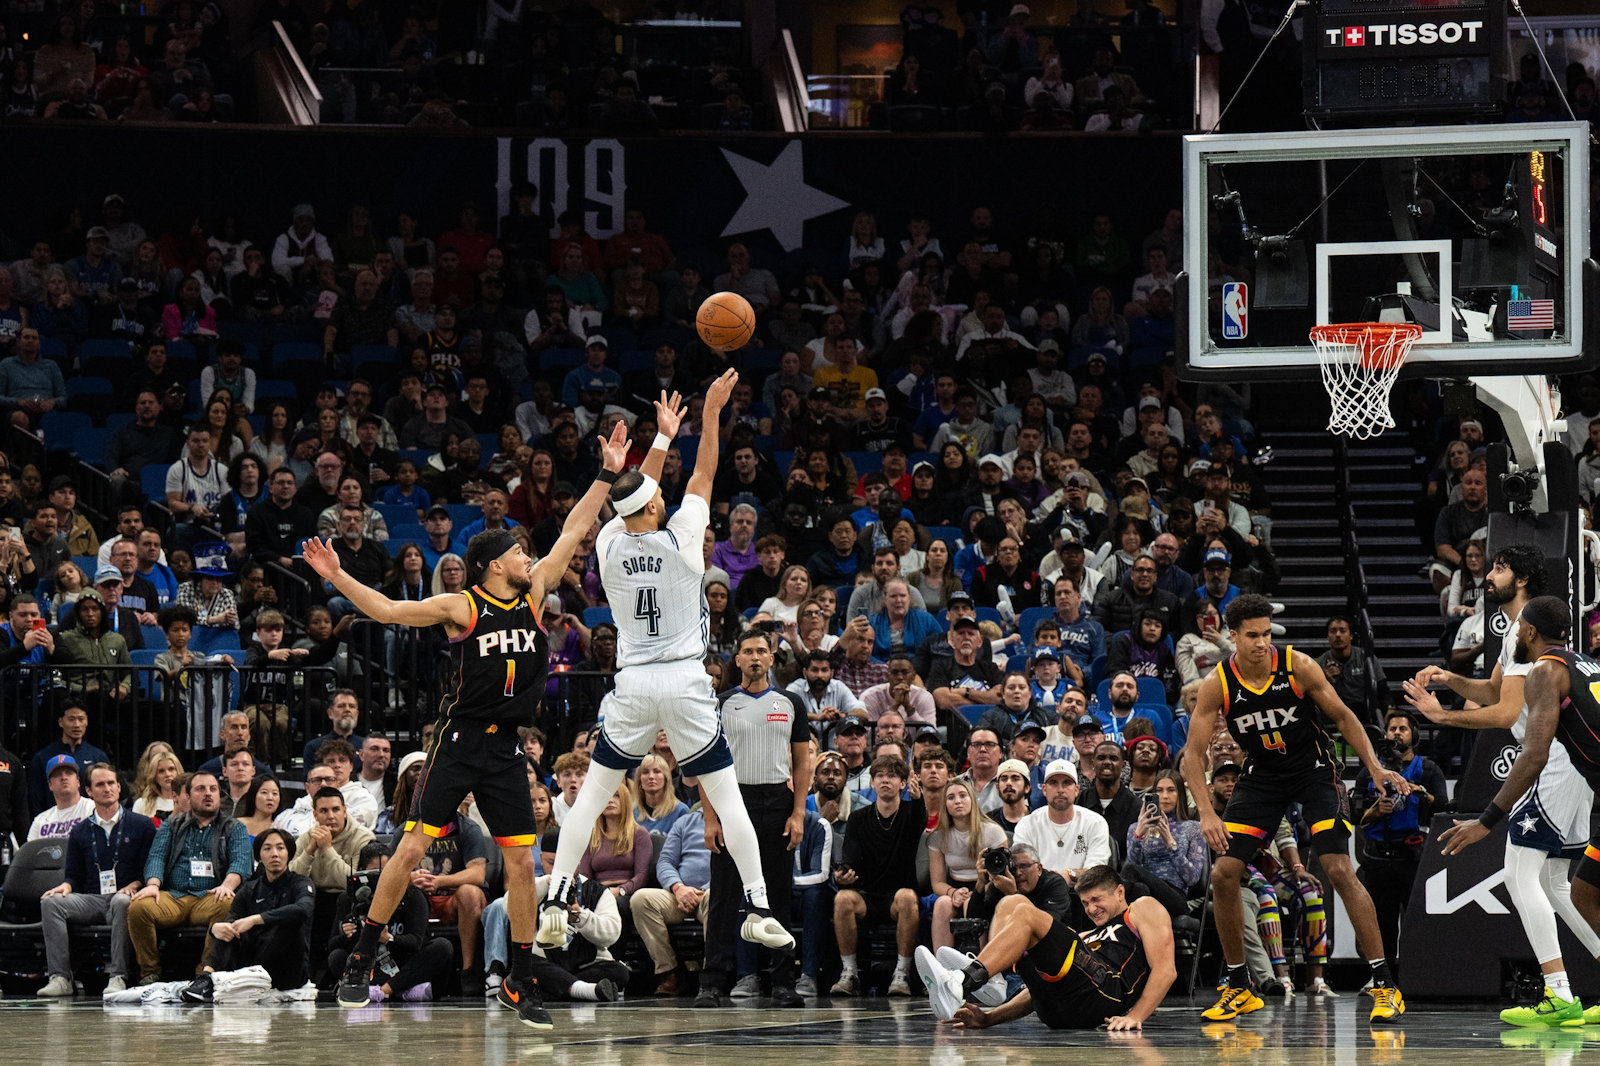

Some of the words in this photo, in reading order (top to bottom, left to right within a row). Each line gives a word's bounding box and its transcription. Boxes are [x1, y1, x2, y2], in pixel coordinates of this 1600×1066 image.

[1368, 21, 1483, 46] TISSOT
[494, 136, 628, 241] 109
[1226, 325, 1239, 336] NBA
[430, 352, 462, 367] PHX
[186, 489, 221, 505] Mgic
[622, 556, 663, 575] SUGGS
[634, 586, 661, 636] 4
[476, 628, 537, 657] PHX
[1060, 628, 1089, 645] agic
[504, 659, 516, 696] 1
[1272, 682, 1289, 691] PayPal
[1233, 706, 1299, 734] PHX
[1042, 743, 1074, 761] PLAY
[1260, 730, 1287, 755] 4
